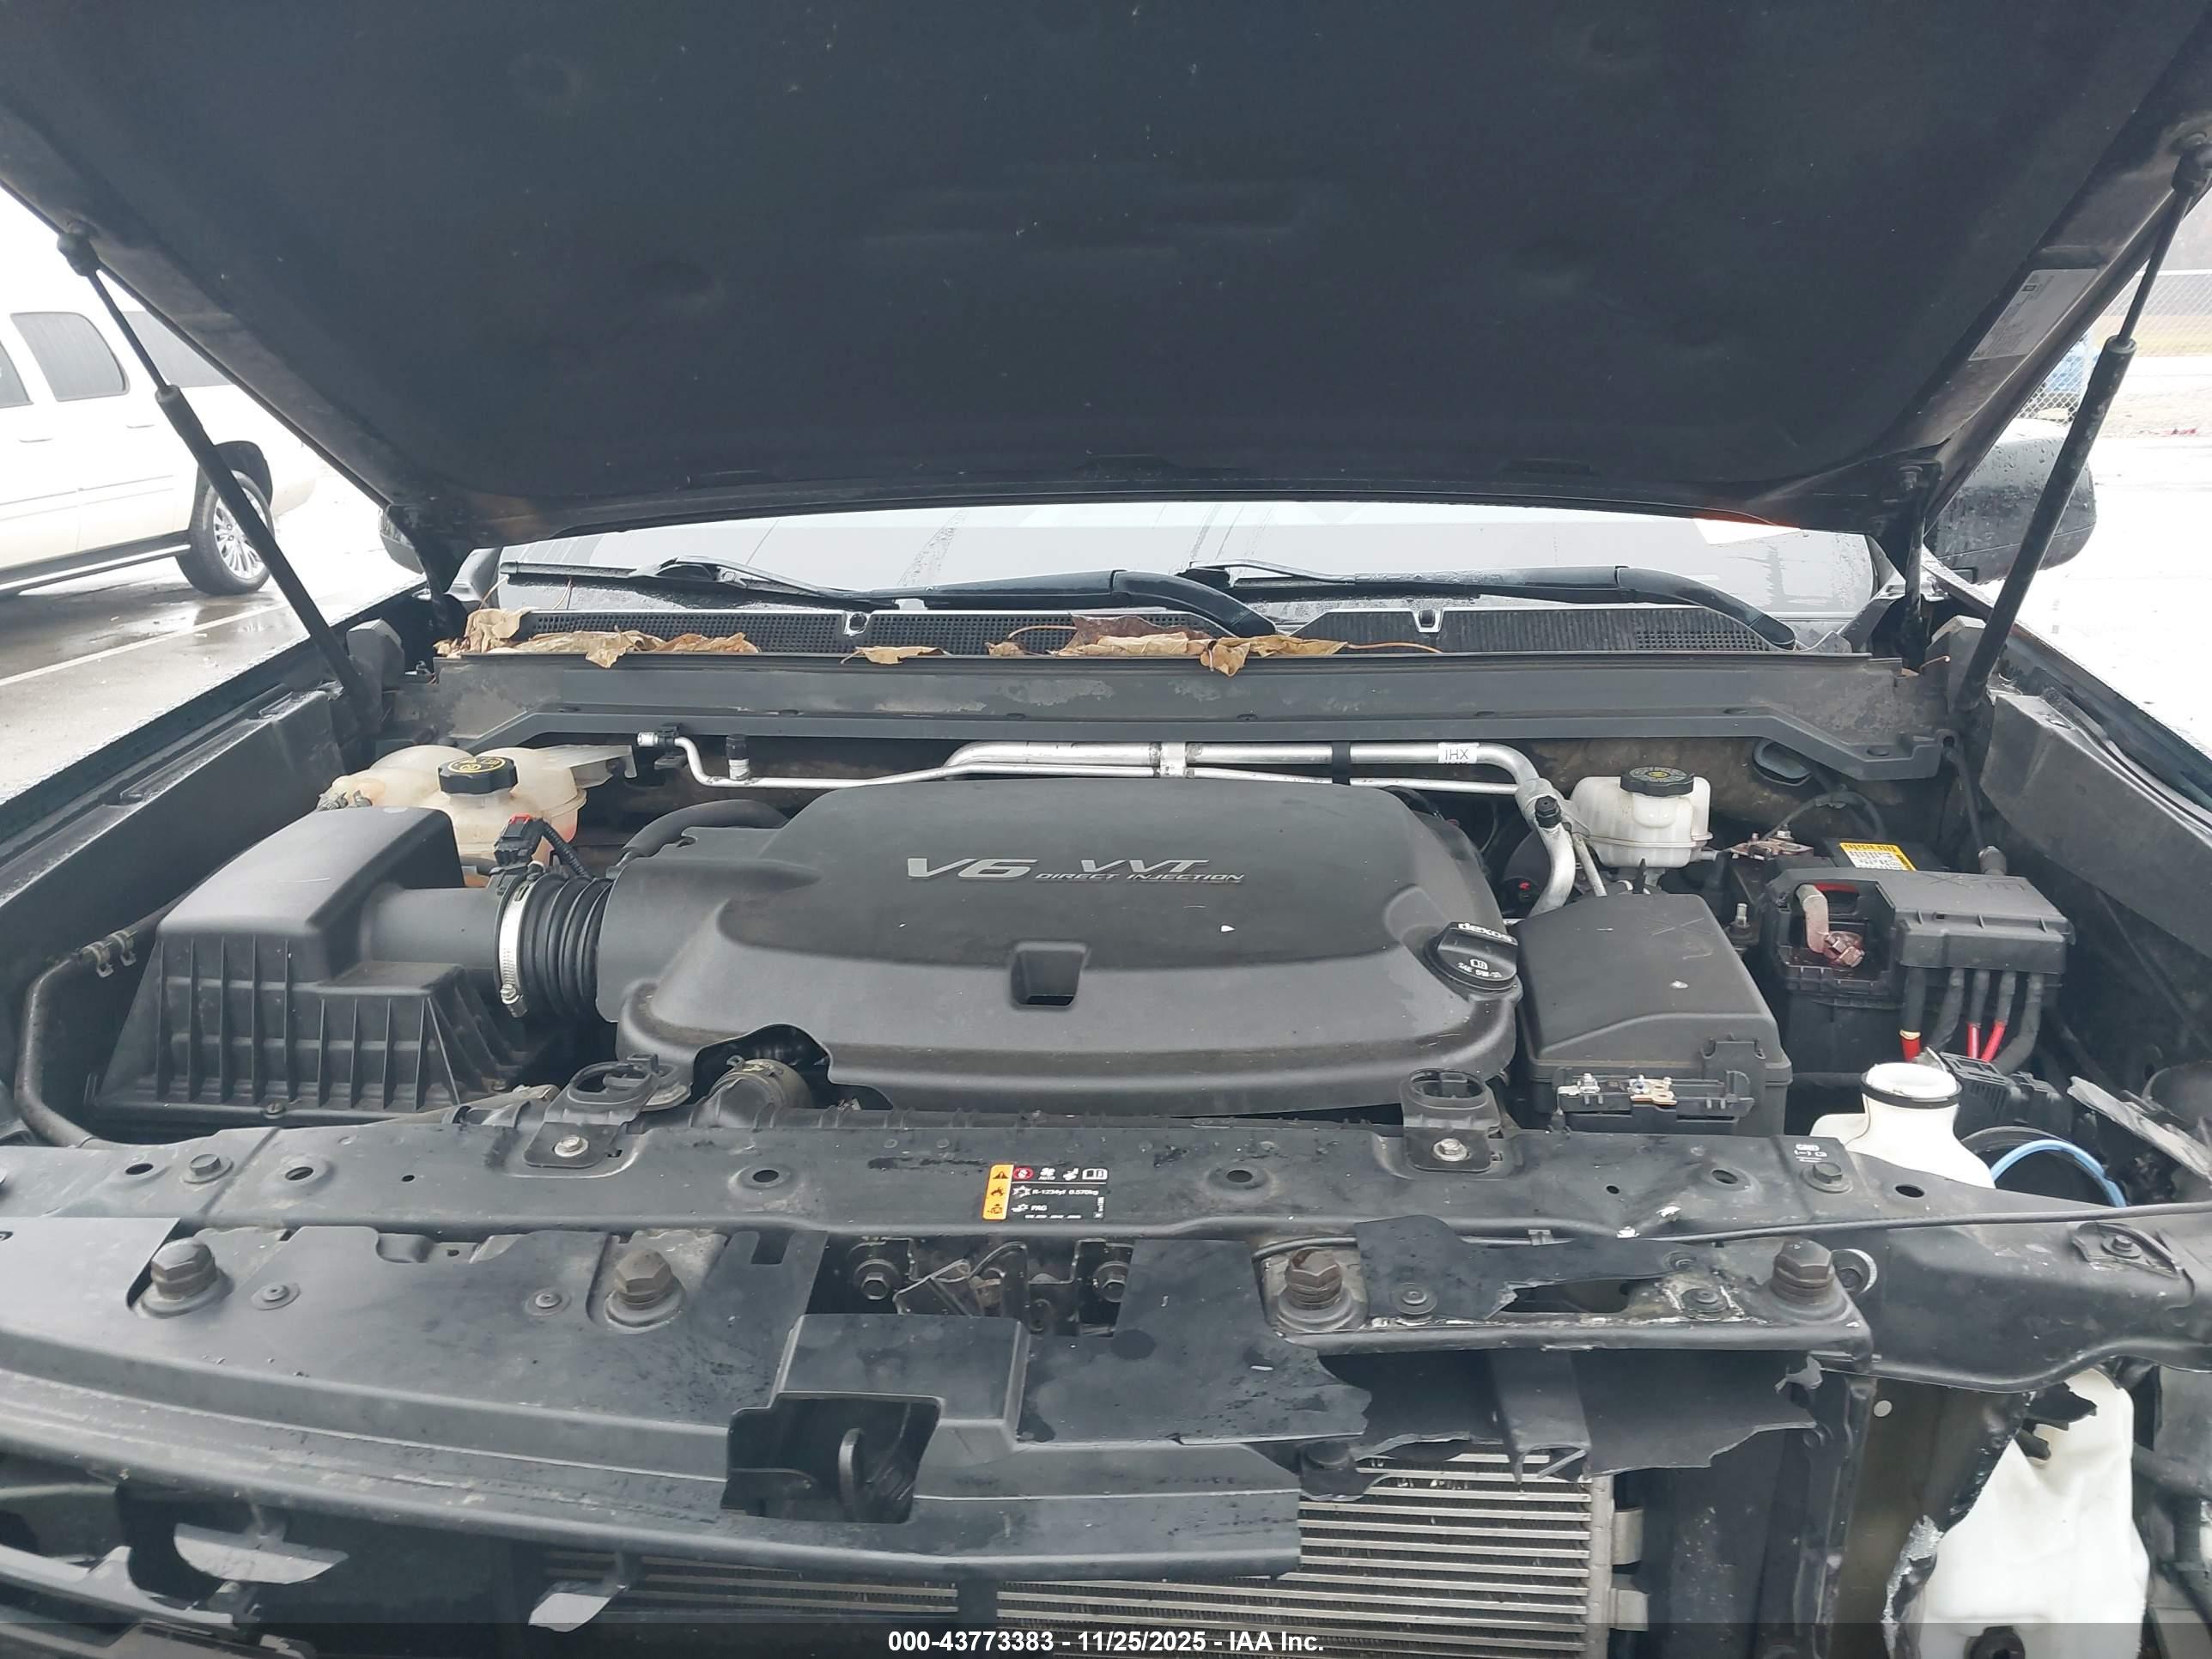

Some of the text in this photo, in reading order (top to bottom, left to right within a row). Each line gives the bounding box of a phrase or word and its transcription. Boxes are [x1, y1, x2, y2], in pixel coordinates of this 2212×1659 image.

[1445, 748, 1469, 760] IHX
[907, 858, 1210, 878] V6 VVT
